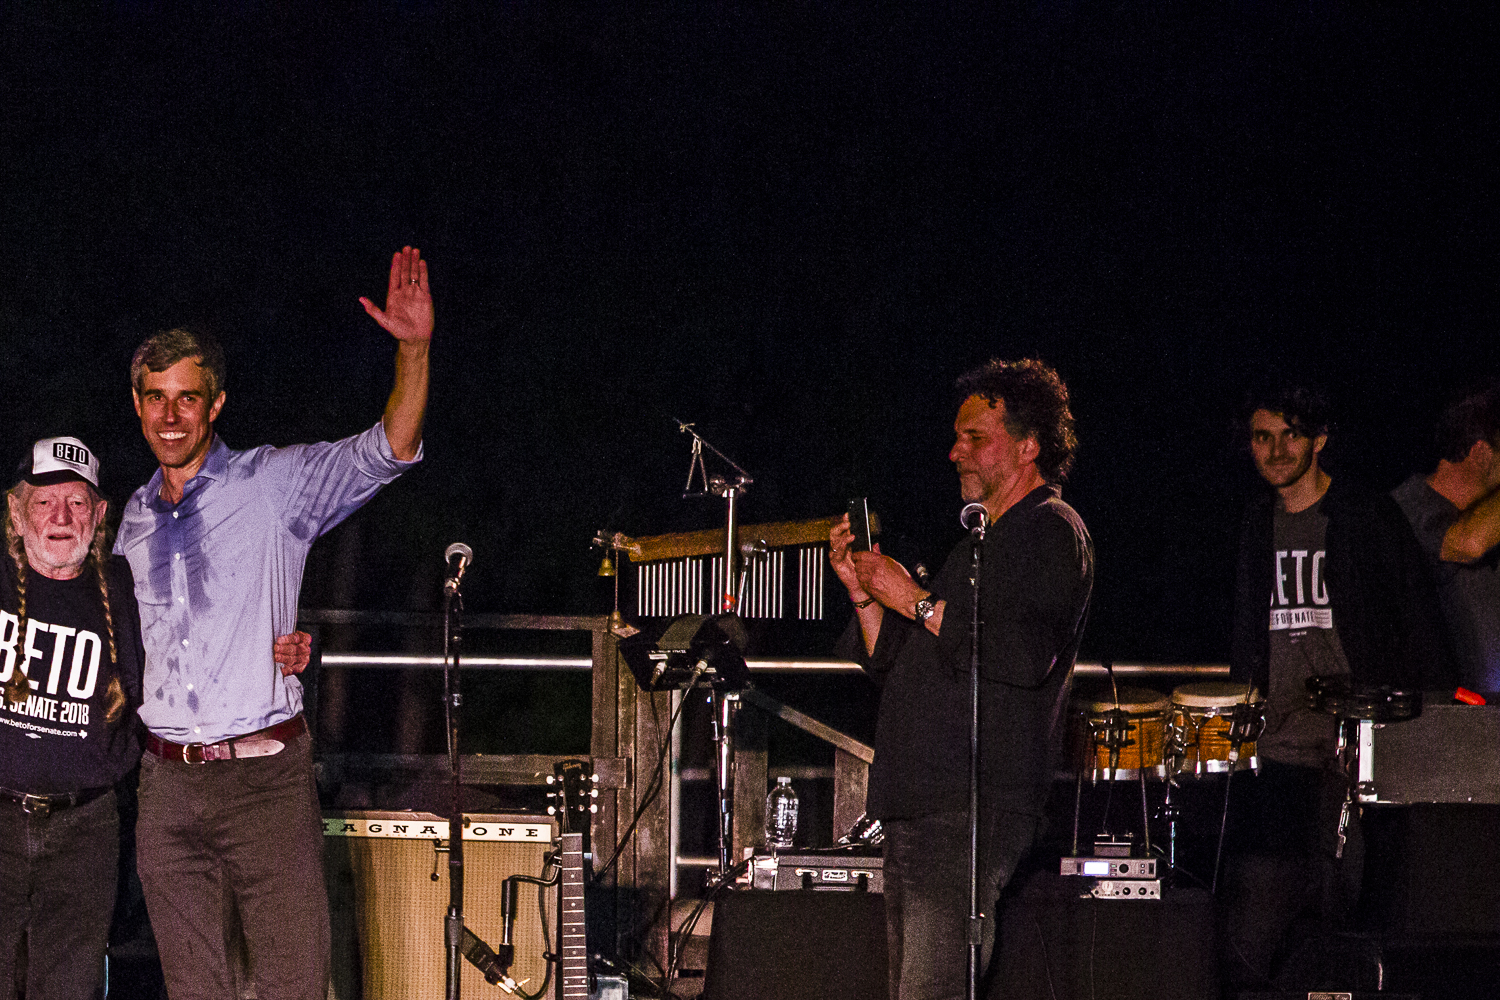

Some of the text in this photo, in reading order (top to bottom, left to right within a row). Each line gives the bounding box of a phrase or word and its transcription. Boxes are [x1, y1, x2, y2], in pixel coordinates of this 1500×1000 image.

[56, 444, 86, 463] BETO
[1270, 550, 1329, 607] ETO
[60, 701, 89, 726] 2018
[322, 822, 539, 838] AGNAONE
